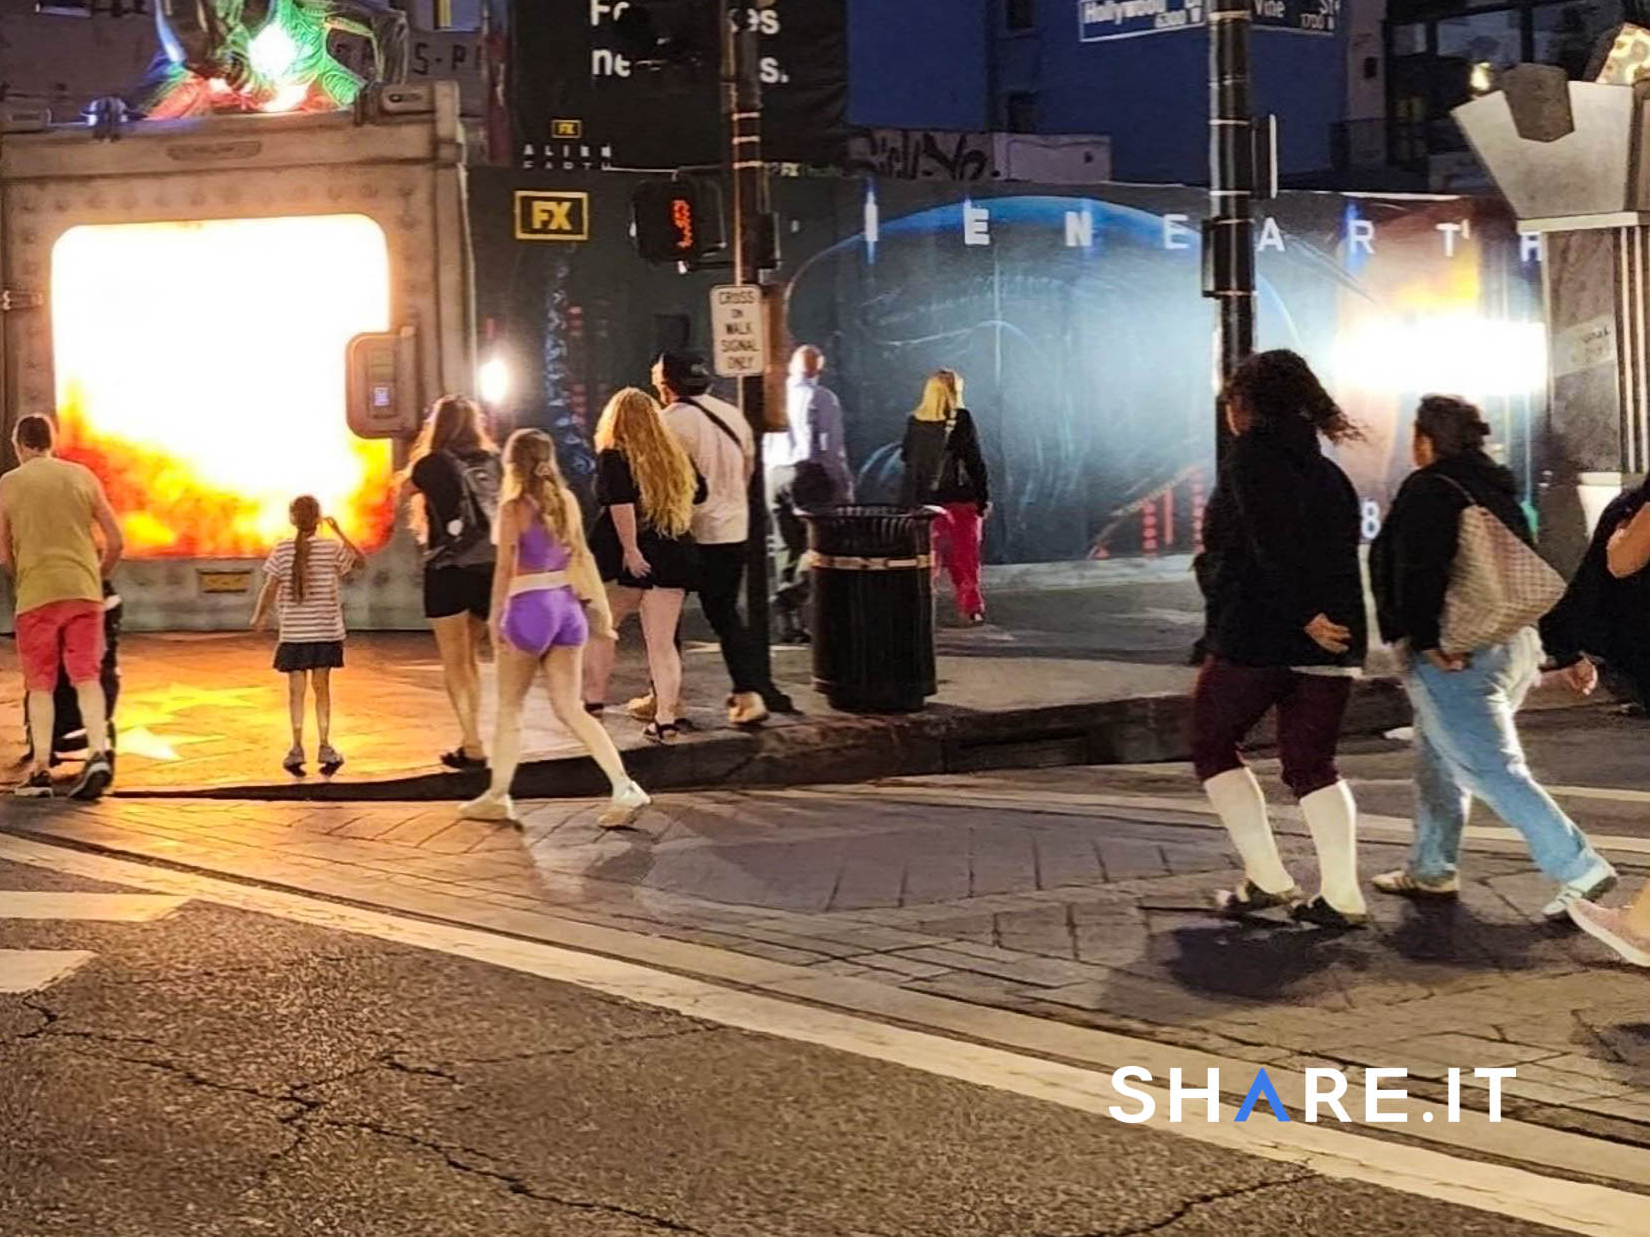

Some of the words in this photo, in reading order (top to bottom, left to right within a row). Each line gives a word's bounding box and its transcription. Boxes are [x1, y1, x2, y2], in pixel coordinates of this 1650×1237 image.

[532, 200, 573, 231] FX
[673, 199, 693, 248] 9
[718, 291, 756, 305] CROSS
[726, 322, 753, 335] WALK
[721, 339, 760, 353] SIGNAL
